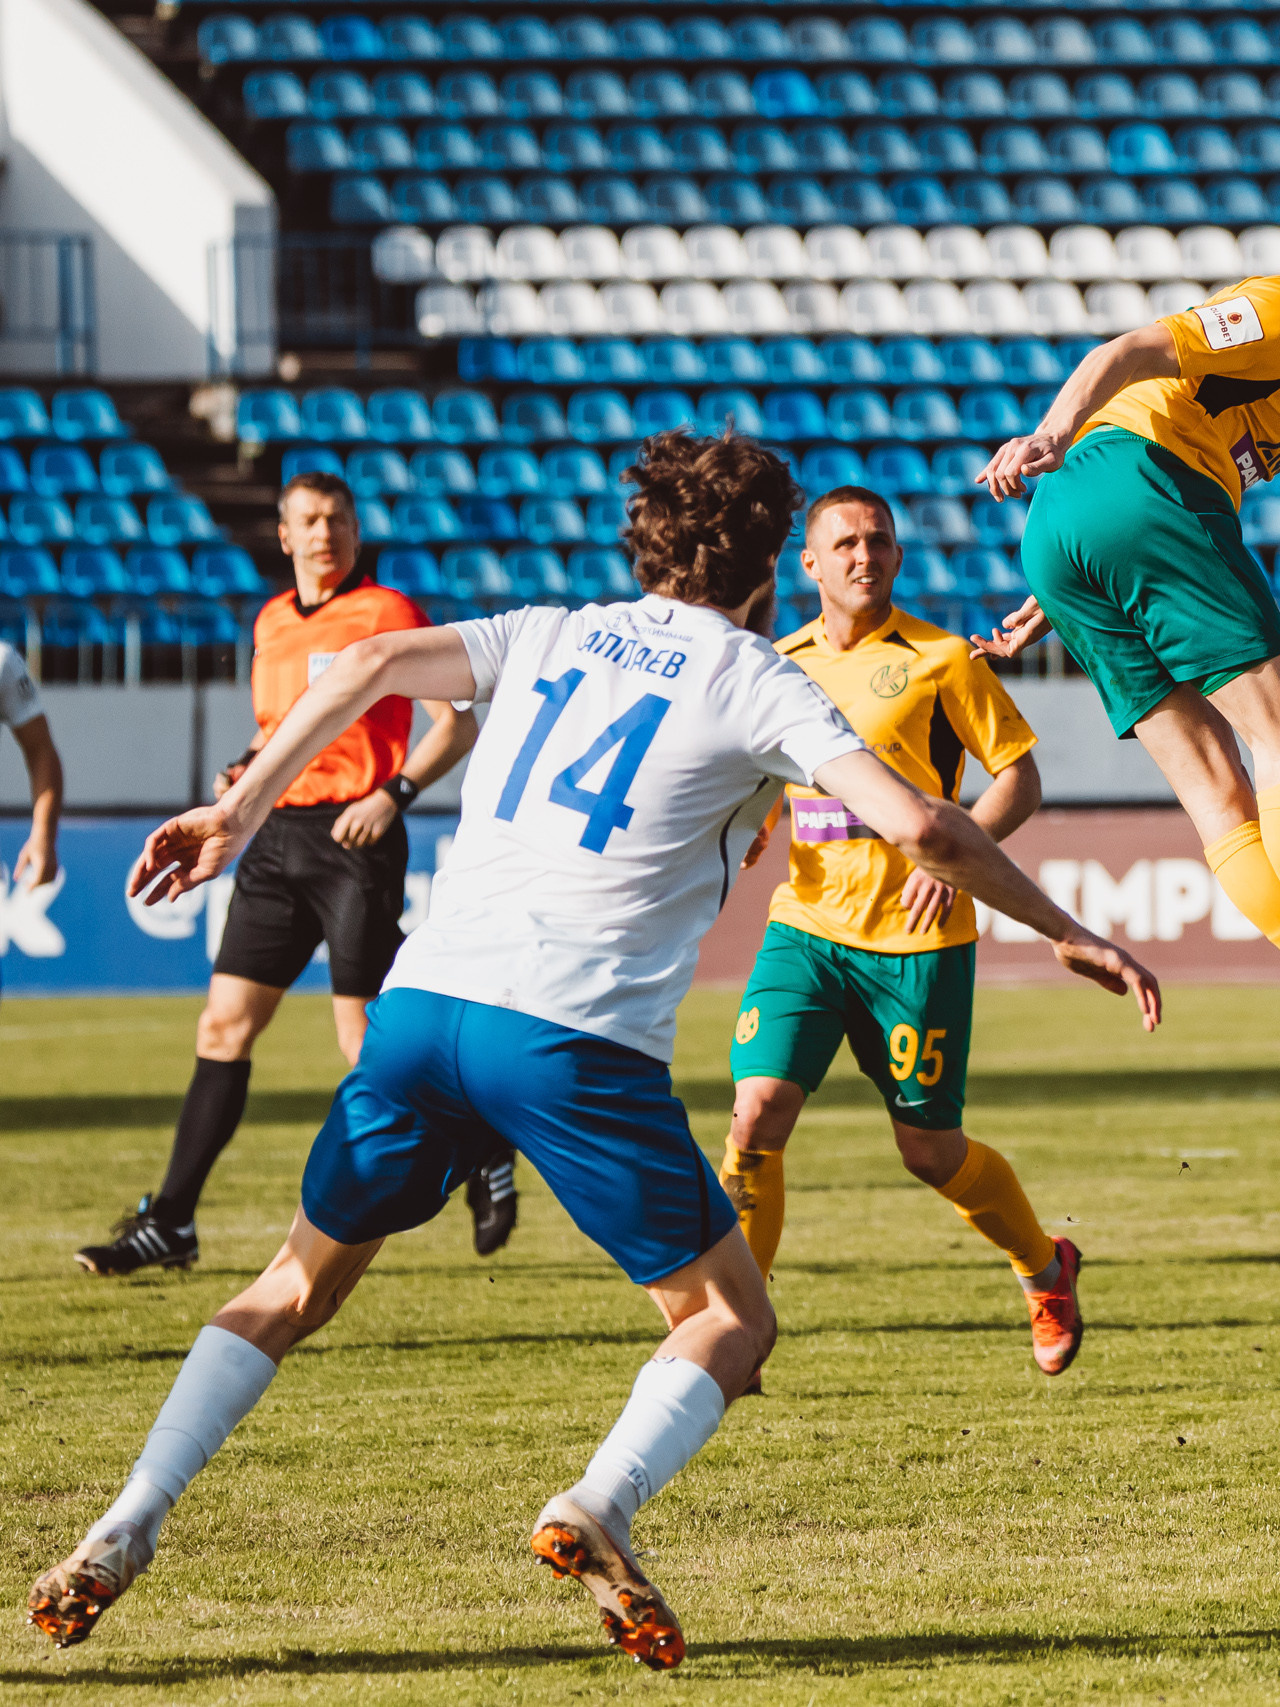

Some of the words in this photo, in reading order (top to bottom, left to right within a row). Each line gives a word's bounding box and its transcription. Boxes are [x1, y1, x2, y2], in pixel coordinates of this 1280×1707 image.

[1210, 307, 1232, 342] OLIMPBET
[495, 667, 673, 855] 14
[889, 1022, 947, 1087] 95
